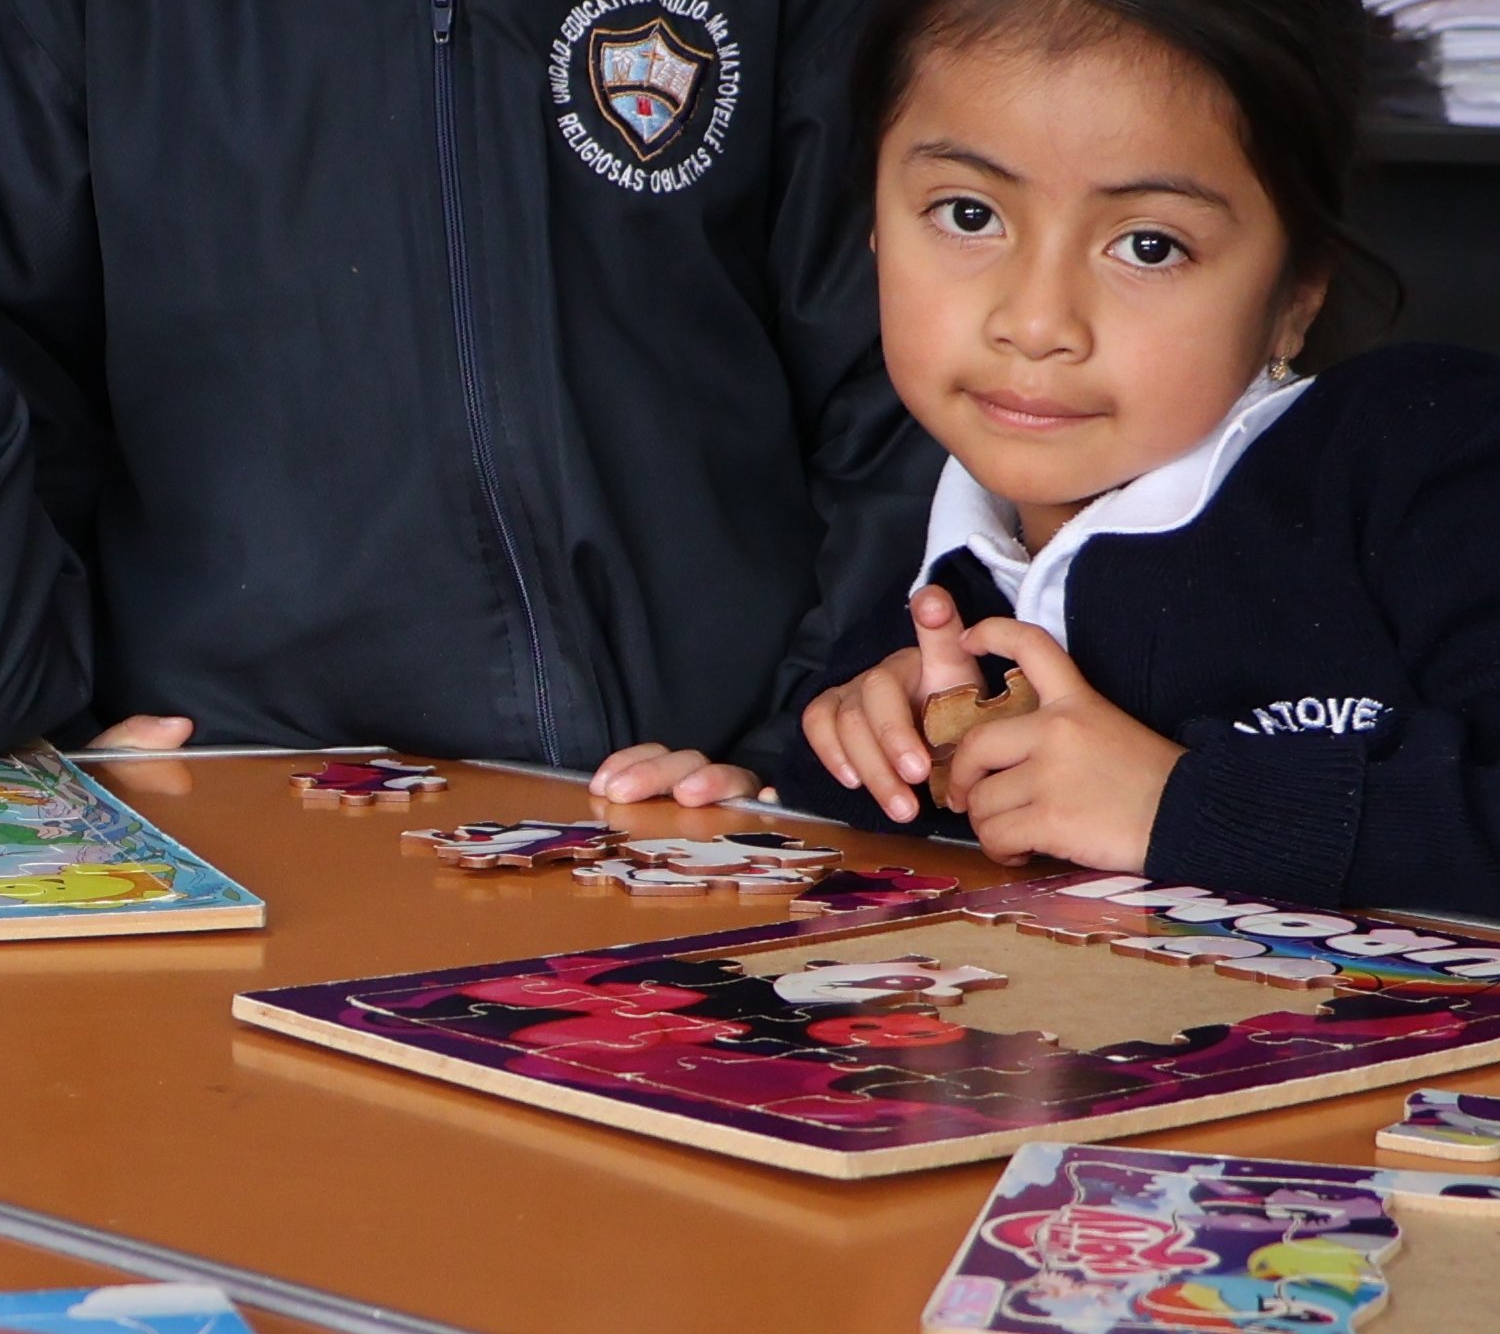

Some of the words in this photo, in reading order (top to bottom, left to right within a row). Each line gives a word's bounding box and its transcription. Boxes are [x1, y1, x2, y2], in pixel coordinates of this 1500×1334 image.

[549, 38, 574, 105] UNIDAD
[703, 41, 741, 154] MATOVELLE
[557, 111, 647, 193] RELIGIOSAS
[650, 146, 713, 194] OBLATAS
